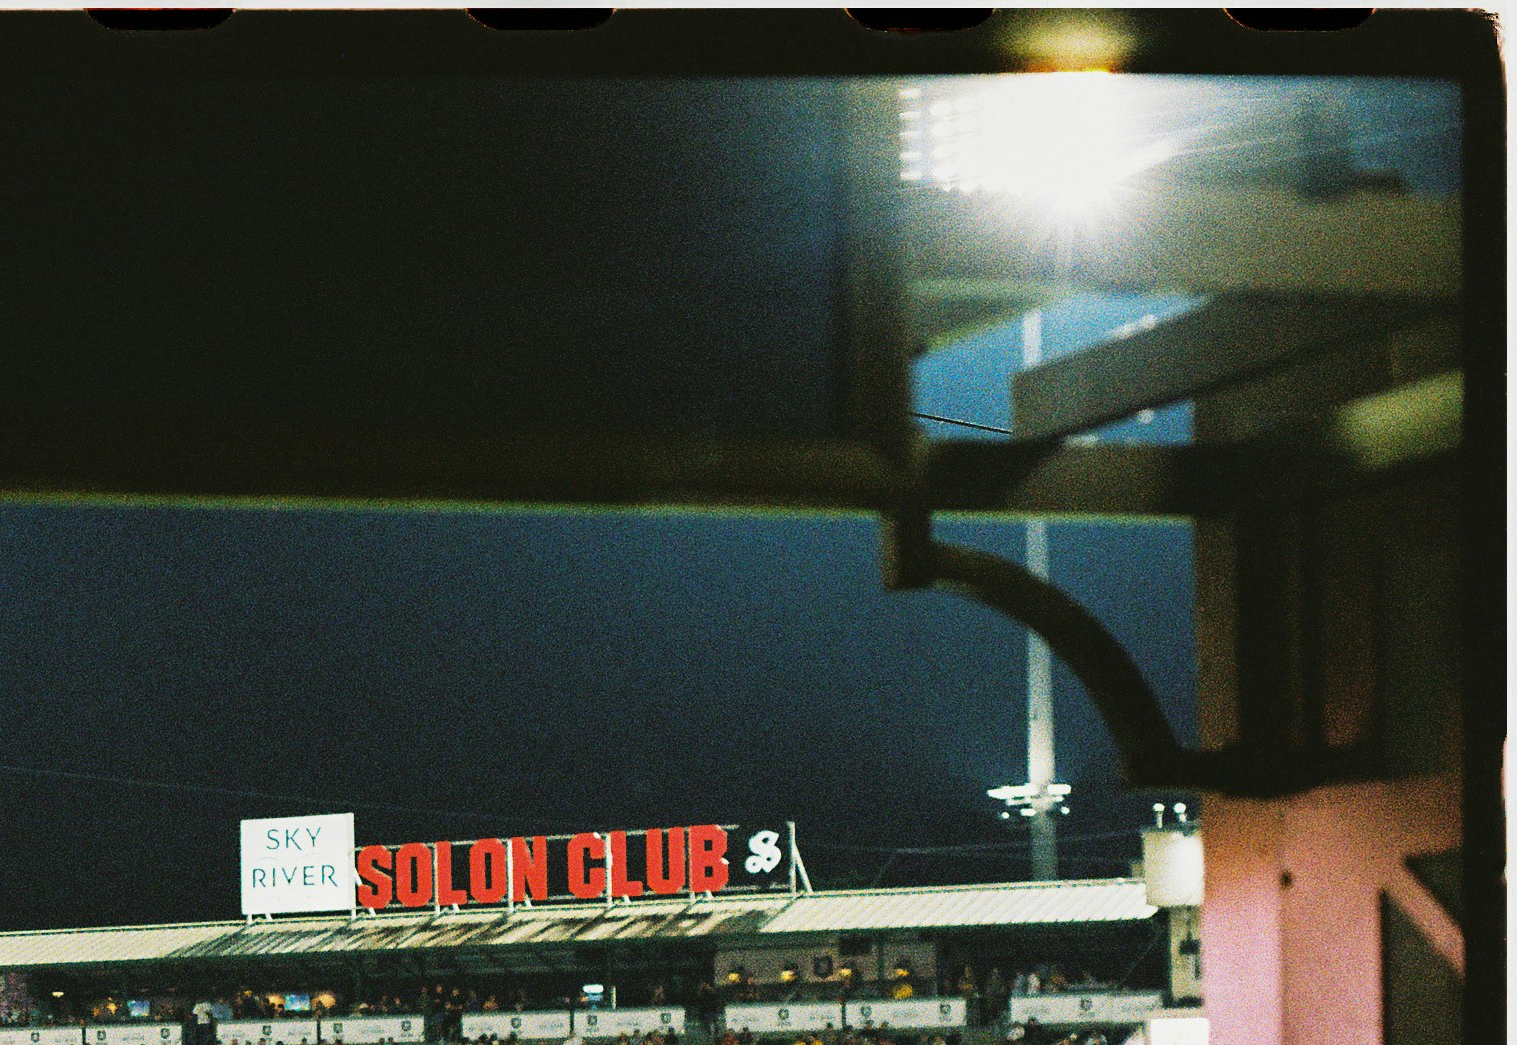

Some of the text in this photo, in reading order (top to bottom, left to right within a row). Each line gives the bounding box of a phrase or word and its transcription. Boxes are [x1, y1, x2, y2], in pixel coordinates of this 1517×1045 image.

[266, 827, 322, 851] SKY
[252, 864, 339, 889] RIVER
[356, 823, 730, 910] SOLON CLUB
